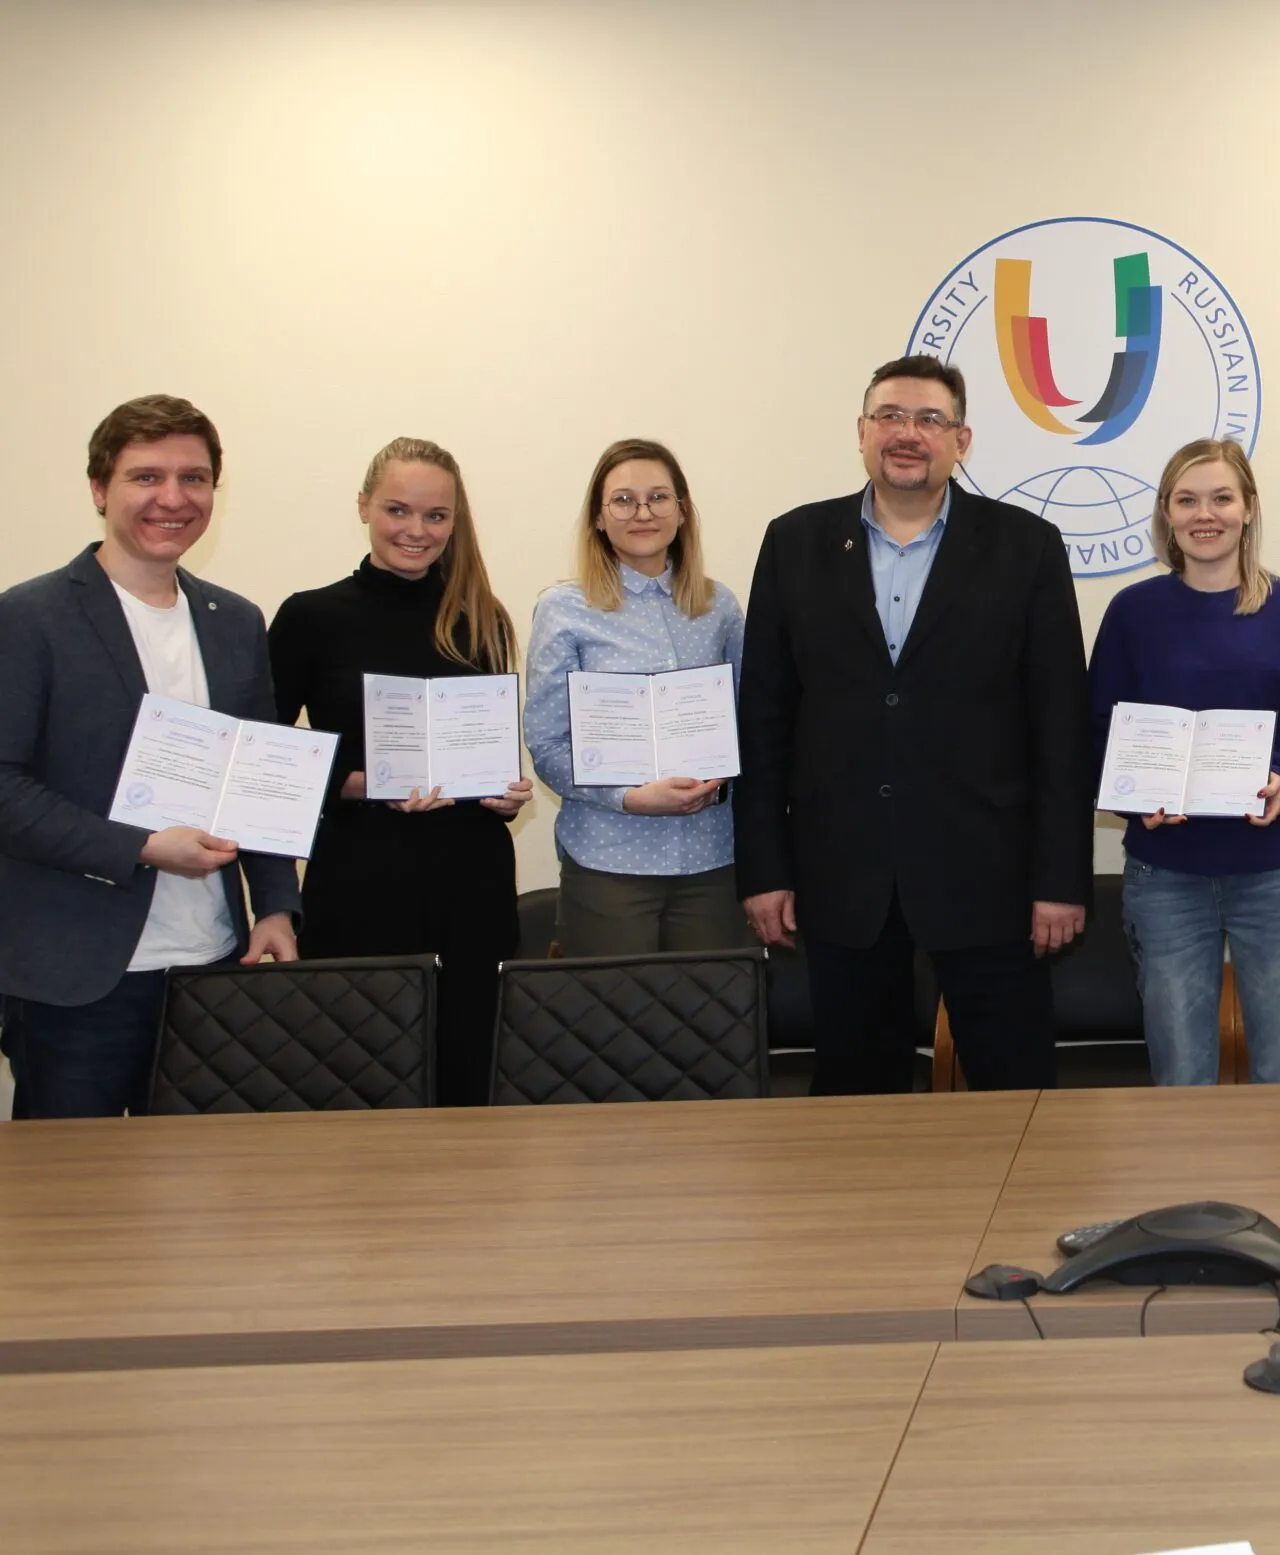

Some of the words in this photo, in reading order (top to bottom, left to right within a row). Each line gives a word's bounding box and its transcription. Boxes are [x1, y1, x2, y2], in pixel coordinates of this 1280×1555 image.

[918, 270, 980, 361] RSITY
[1177, 270, 1249, 393] RUSSIAN
[1223, 411, 1248, 444] IN
